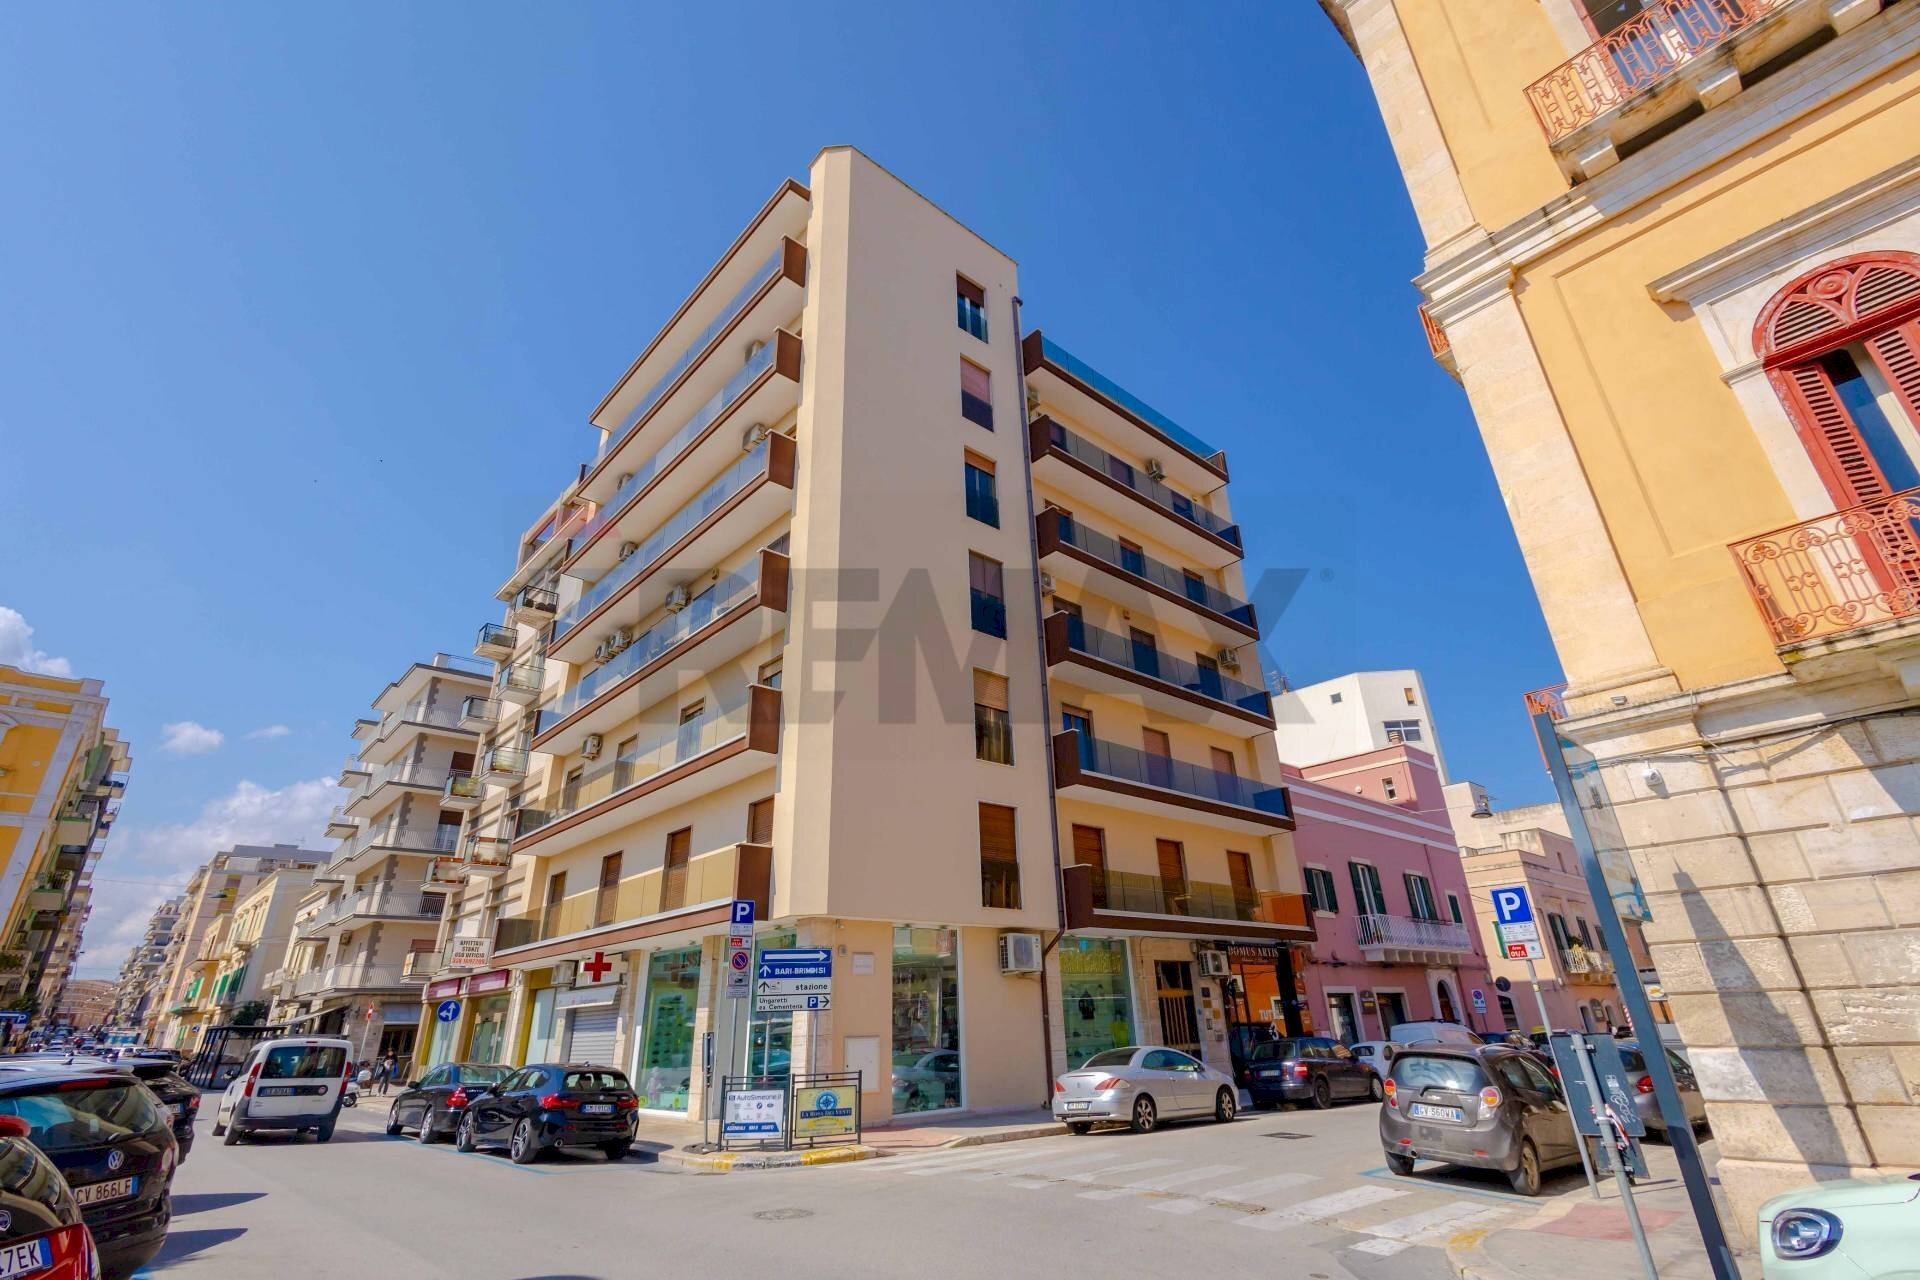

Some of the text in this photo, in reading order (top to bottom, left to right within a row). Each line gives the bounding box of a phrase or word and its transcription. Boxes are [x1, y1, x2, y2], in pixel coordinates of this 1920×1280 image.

[736, 903, 750, 921] P
[1498, 892, 1520, 920] P
[1228, 946, 1256, 956] DOMUS
[795, 983, 828, 991] stazione
[759, 997, 788, 1005] Ungaretti
[0, 1239, 41, 1275] 7EK
